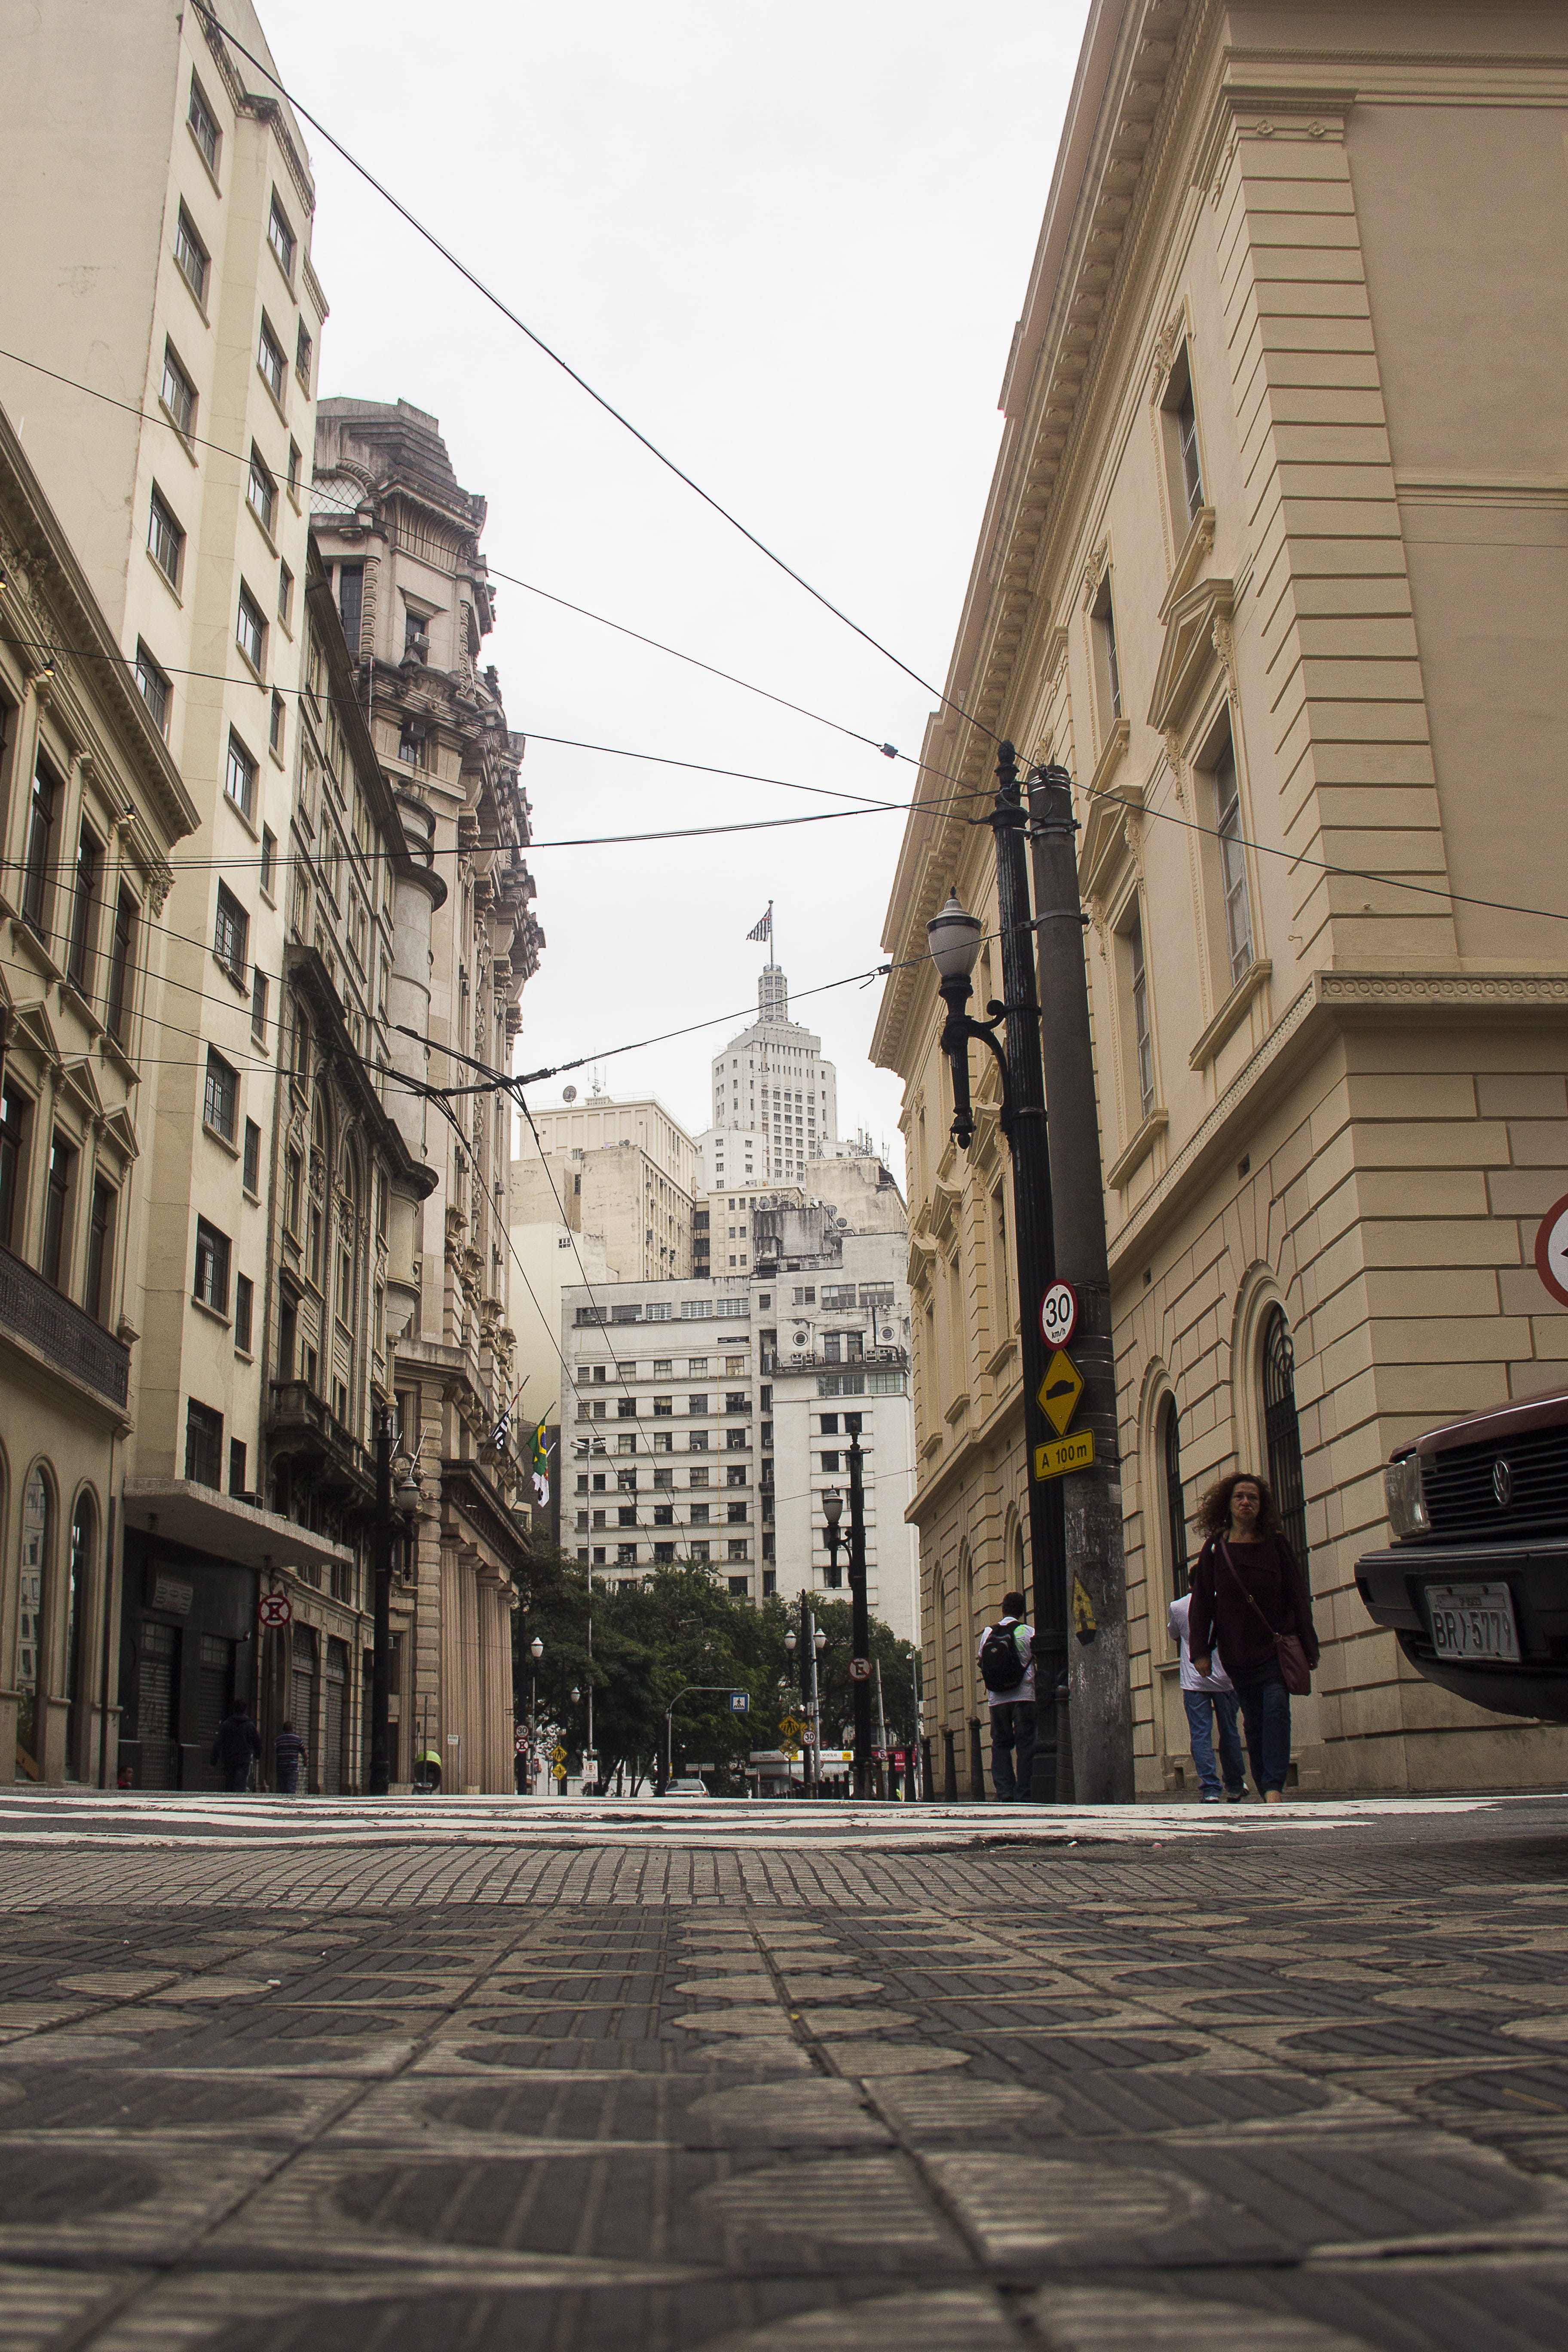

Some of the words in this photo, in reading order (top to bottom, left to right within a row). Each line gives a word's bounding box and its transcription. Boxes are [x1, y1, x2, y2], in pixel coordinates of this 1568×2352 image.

[1045, 1293, 1070, 1328] 30
[1051, 1327, 1066, 1339] km/h
[1042, 1453, 1050, 1469] A
